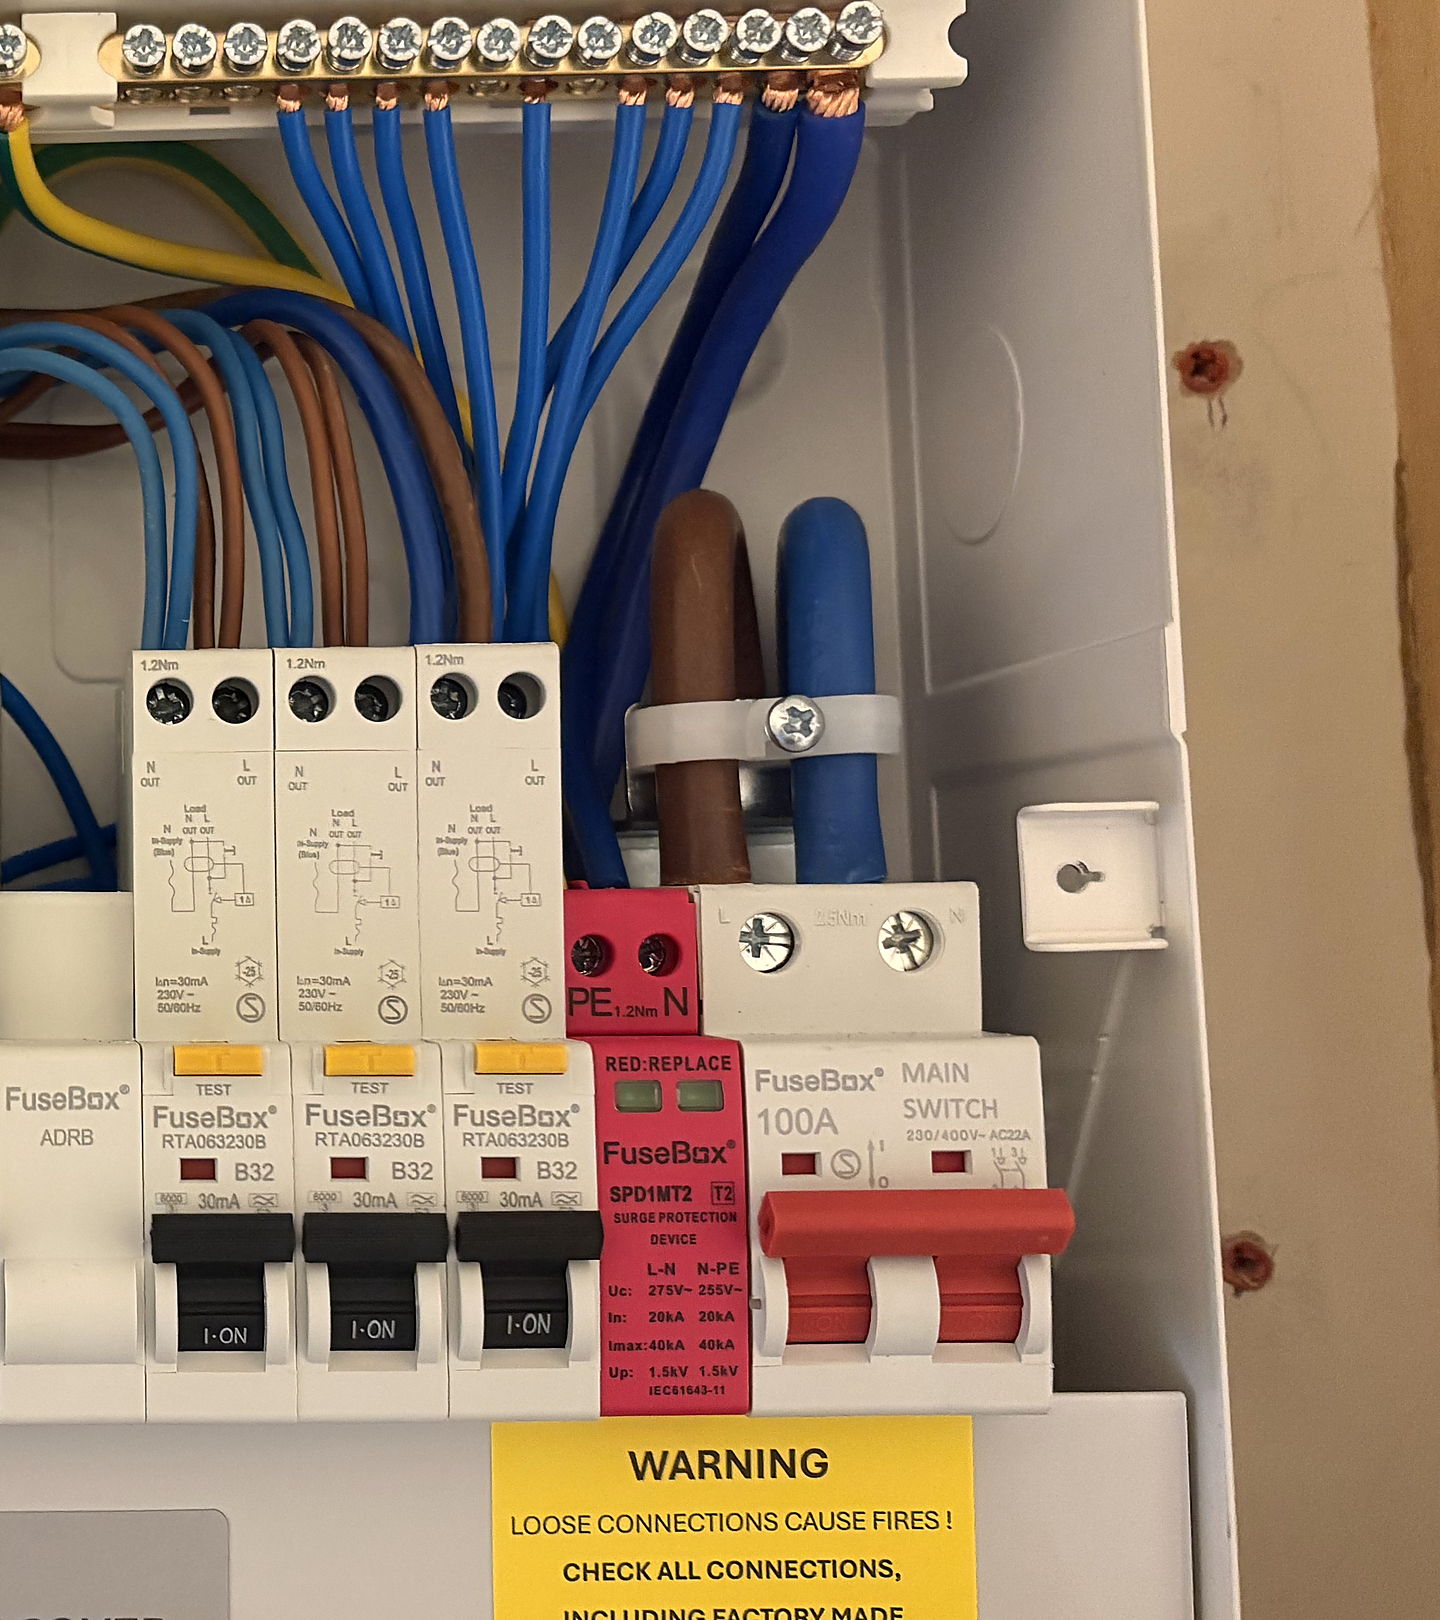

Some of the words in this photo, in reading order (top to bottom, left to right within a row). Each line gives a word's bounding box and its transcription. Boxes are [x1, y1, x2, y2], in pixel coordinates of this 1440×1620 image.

[140, 660, 179, 671] 1.2Nm
[287, 659, 325, 670] 1.2Nm
[425, 654, 464, 666] 1.2Nm
[147, 761, 155, 772] N
[243, 760, 250, 771] L
[432, 761, 441, 772] N
[532, 760, 538, 771] L
[141, 777, 160, 787] OUT
[237, 776, 256, 785] OUT
[426, 776, 445, 786] OUT
[526, 775, 545, 785] OUT
[568, 987, 613, 1017] PE
[615, 1005, 658, 1018] 1.2Nm
[664, 988, 688, 1015] N
[606, 1056, 731, 1071] RED:REPLACE
[902, 1063, 969, 1083] MAIN
[196, 1084, 231, 1095] TEST
[351, 1082, 388, 1094] TEST
[497, 1083, 533, 1094] TEST
[903, 1099, 997, 1118] SWITCH
[757, 1108, 838, 1135] 100A
[40, 1129, 93, 1146] ADRB
[315, 1132, 425, 1147] RTA063230B
[463, 1133, 569, 1148] RTA063230B
[990, 1129, 1031, 1141] AC22A
[162, 1134, 266, 1149] RTA063230B
[235, 1163, 274, 1181] B32
[392, 1162, 433, 1180] B32
[537, 1162, 577, 1180] B32
[500, 1192, 542, 1208] 30mA
[610, 1186, 692, 1202] SPD1MT2
[714, 1187, 732, 1199] T2
[198, 1193, 240, 1209] 30mA
[353, 1192, 397, 1209] 30mA
[614, 1213, 655, 1223] SURGE
[659, 1212, 736, 1223] PROTECTION
[651, 1234, 696, 1245] DEVICE
[648, 1263, 676, 1275] L-N
[698, 1262, 739, 1275] N-PE
[608, 1286, 632, 1296] Uc:
[608, 1313, 626, 1323] In:
[649, 1312, 684, 1322] 20kA
[699, 1311, 734, 1321] 20kA
[649, 1340, 684, 1350] 40kA
[699, 1339, 734, 1350] 40kA
[609, 1367, 633, 1379] Up:
[649, 1366, 688, 1377] 1.5kV
[699, 1366, 738, 1376] 1.5kV
[649, 1386, 725, 1395] IEC61643-11
[628, 1448, 829, 1480] WARNING
[511, 1516, 590, 1535] LOOSE
[598, 1512, 778, 1533] CONNECTIONS
[784, 1511, 865, 1531] CAUSE
[563, 1561, 652, 1581] CHECK
[657, 1560, 701, 1580] ALL
[706, 1559, 902, 1581] CONNECTIONS,
